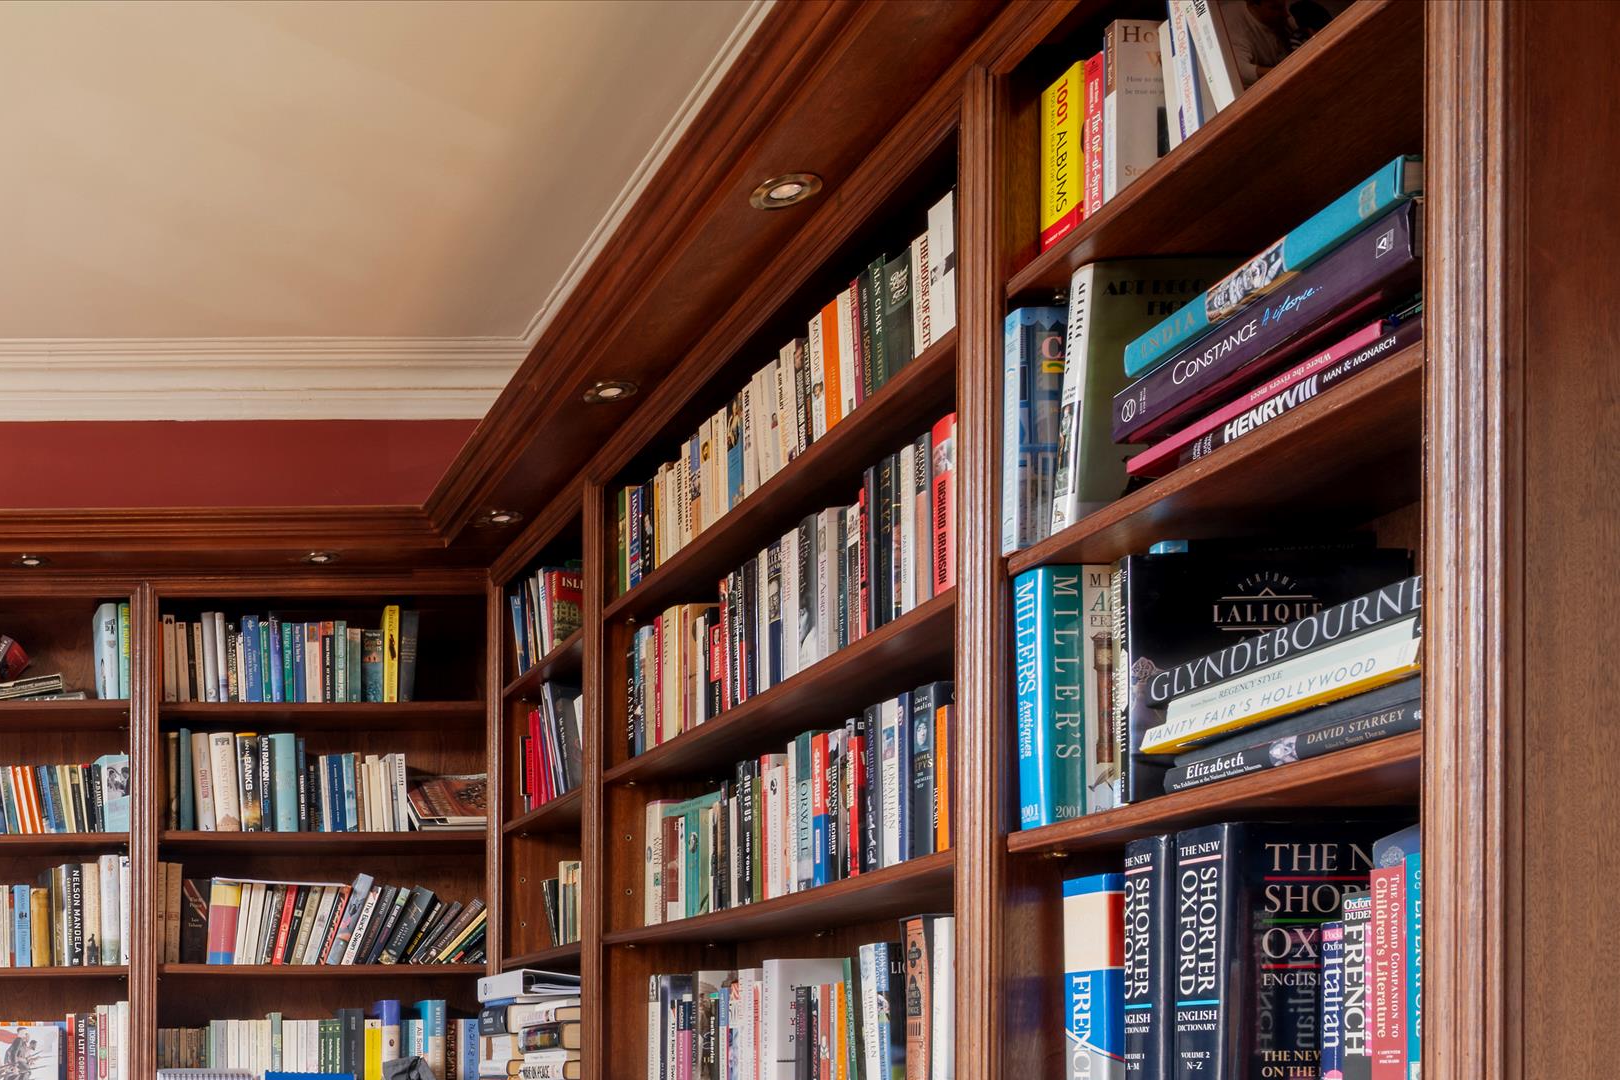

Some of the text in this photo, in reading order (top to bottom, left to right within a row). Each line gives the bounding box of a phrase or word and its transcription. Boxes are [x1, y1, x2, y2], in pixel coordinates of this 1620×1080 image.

[1056, 79, 1068, 126] 1001
[1056, 130, 1068, 213] ALBUMS
[1140, 311, 1196, 359] INDIA
[1172, 319, 1257, 385] CONSTANCE
[1322, 336, 1397, 384] MAN MONARCH
[937, 480, 947, 586] RICHARD BRANSON
[1238, 570, 1297, 592] PERFUME
[1016, 578, 1036, 696] MILLER'S
[1150, 574, 1422, 702] GLYNDEBOURNE
[1052, 574, 1081, 759] MILLER'S
[1218, 677, 1258, 700] REGENCY
[1147, 657, 1377, 743] VANITY FAIR'S HOLLYWOOD
[1023, 699, 1033, 758] Antiques
[1306, 709, 1405, 745] DAVID STARKEY
[245, 757, 253, 790] BANKS
[1186, 752, 1244, 780] Elizabeth
[1055, 805, 1081, 819] 2001
[1135, 853, 1152, 866] NEW
[1180, 840, 1220, 857] THE NEW
[1265, 843, 1338, 872] THE
[72, 869, 82, 953] NELSON MANDELA
[1180, 870, 1199, 996] OXFORD
[1198, 867, 1218, 995] SHORTER
[1134, 878, 1150, 998] SHORTER
[1376, 877, 1388, 1038] Children's Literature
[1390, 874, 1399, 1038] THE OXFORD COMPANION TO
[1323, 956, 1343, 1050] Italian
[1344, 924, 1365, 1056] FRENCH
[1177, 1010, 1218, 1022] ENGLISH
[1177, 1023, 1217, 1032] DICTIONARY
[1181, 1052, 1202, 1060] VOLUME
[1262, 1050, 1291, 1062] THE
[1262, 1066, 1315, 1078] ON THE
